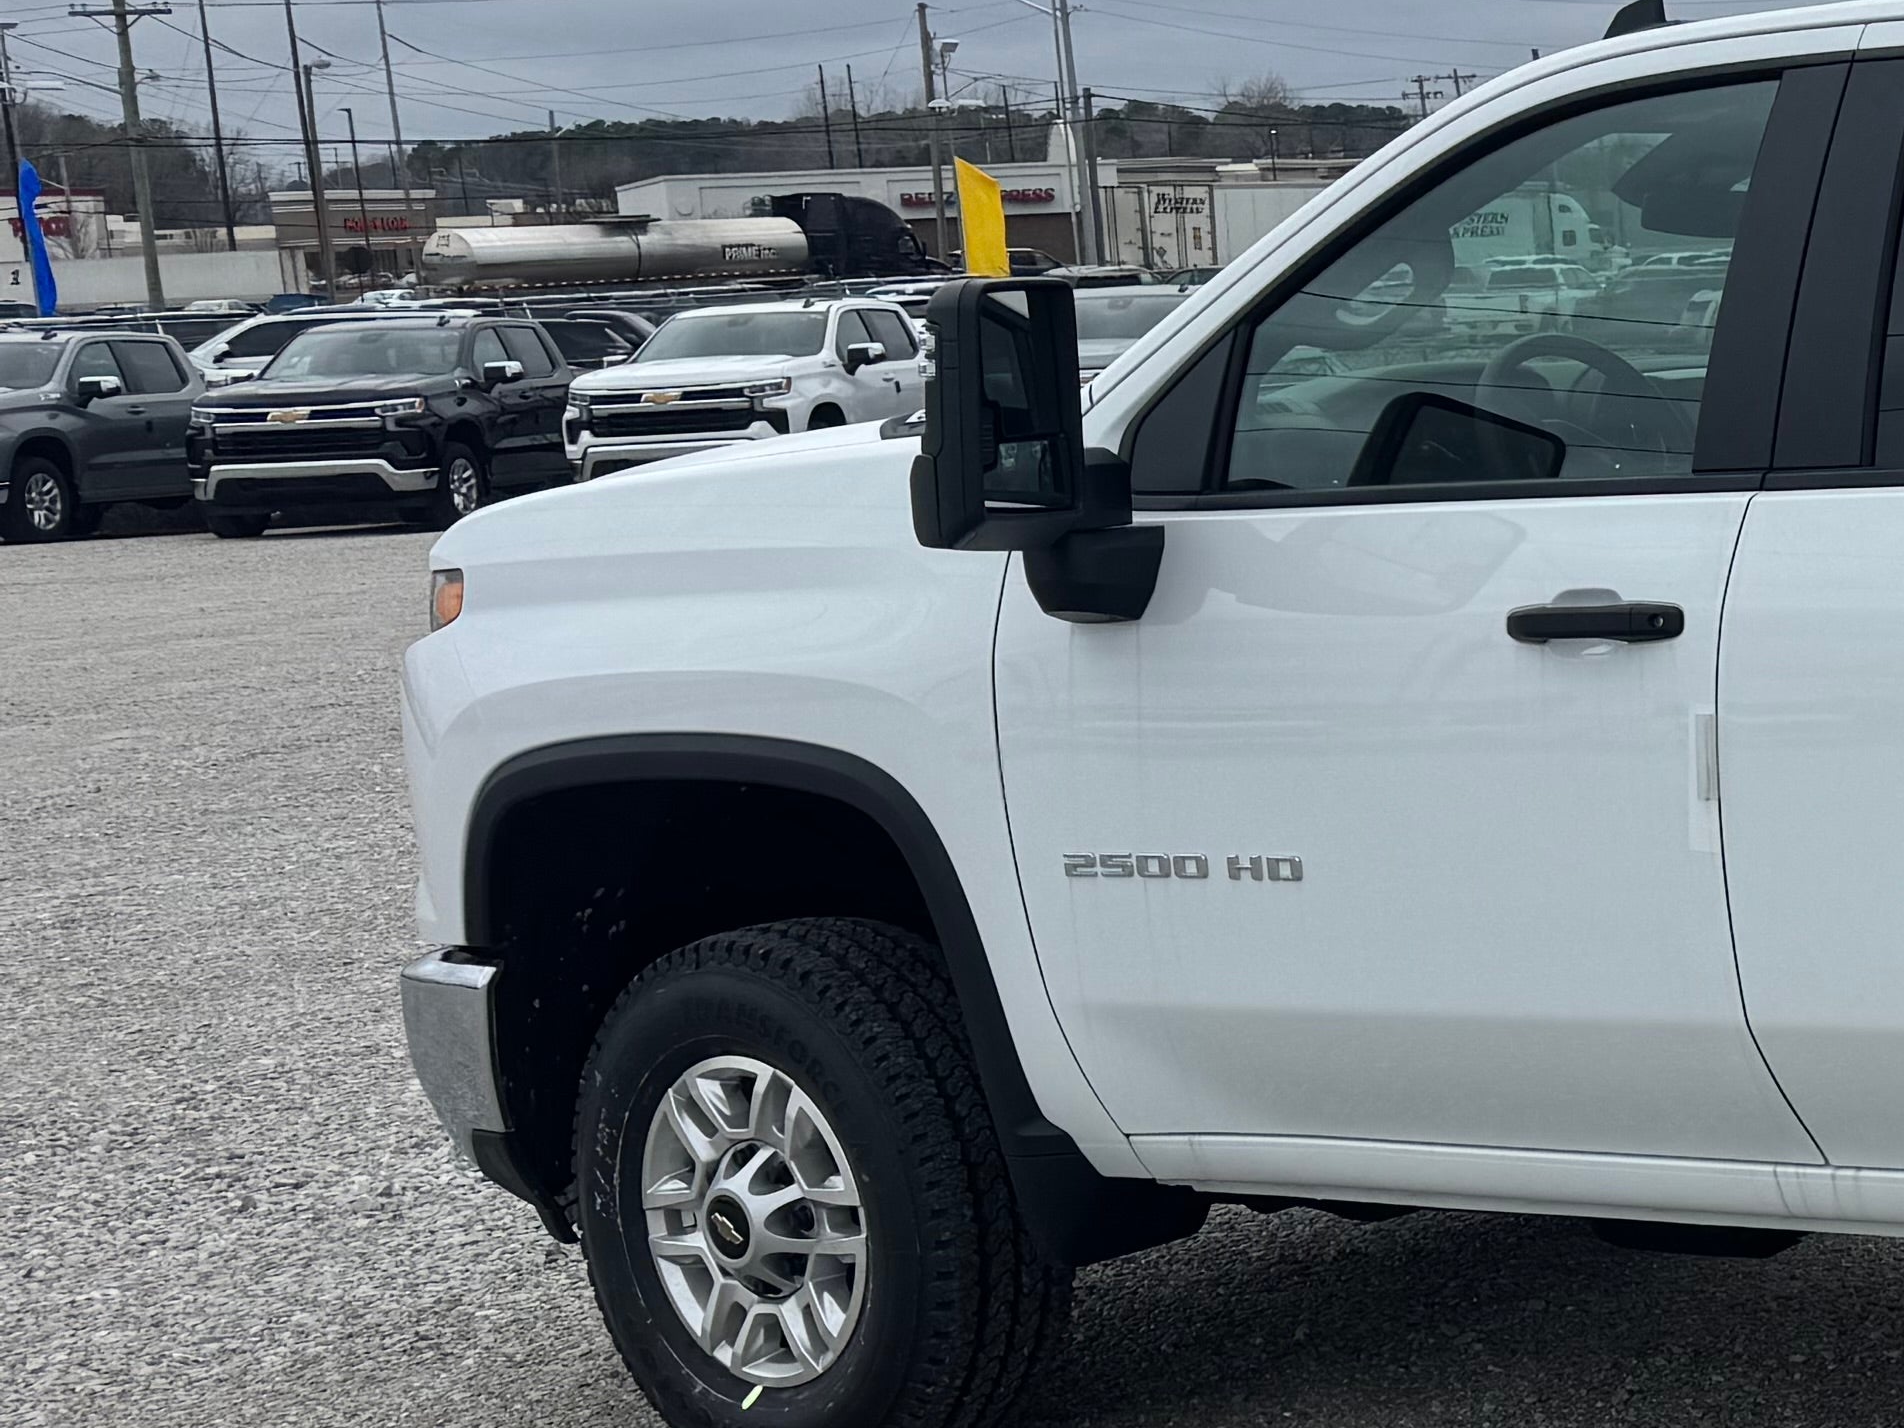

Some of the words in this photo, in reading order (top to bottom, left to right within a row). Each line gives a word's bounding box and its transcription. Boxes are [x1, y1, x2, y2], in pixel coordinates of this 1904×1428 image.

[1001, 188, 1055, 203] PRESS
[1063, 852, 1209, 878] 2500
[1227, 854, 1303, 881] HD
